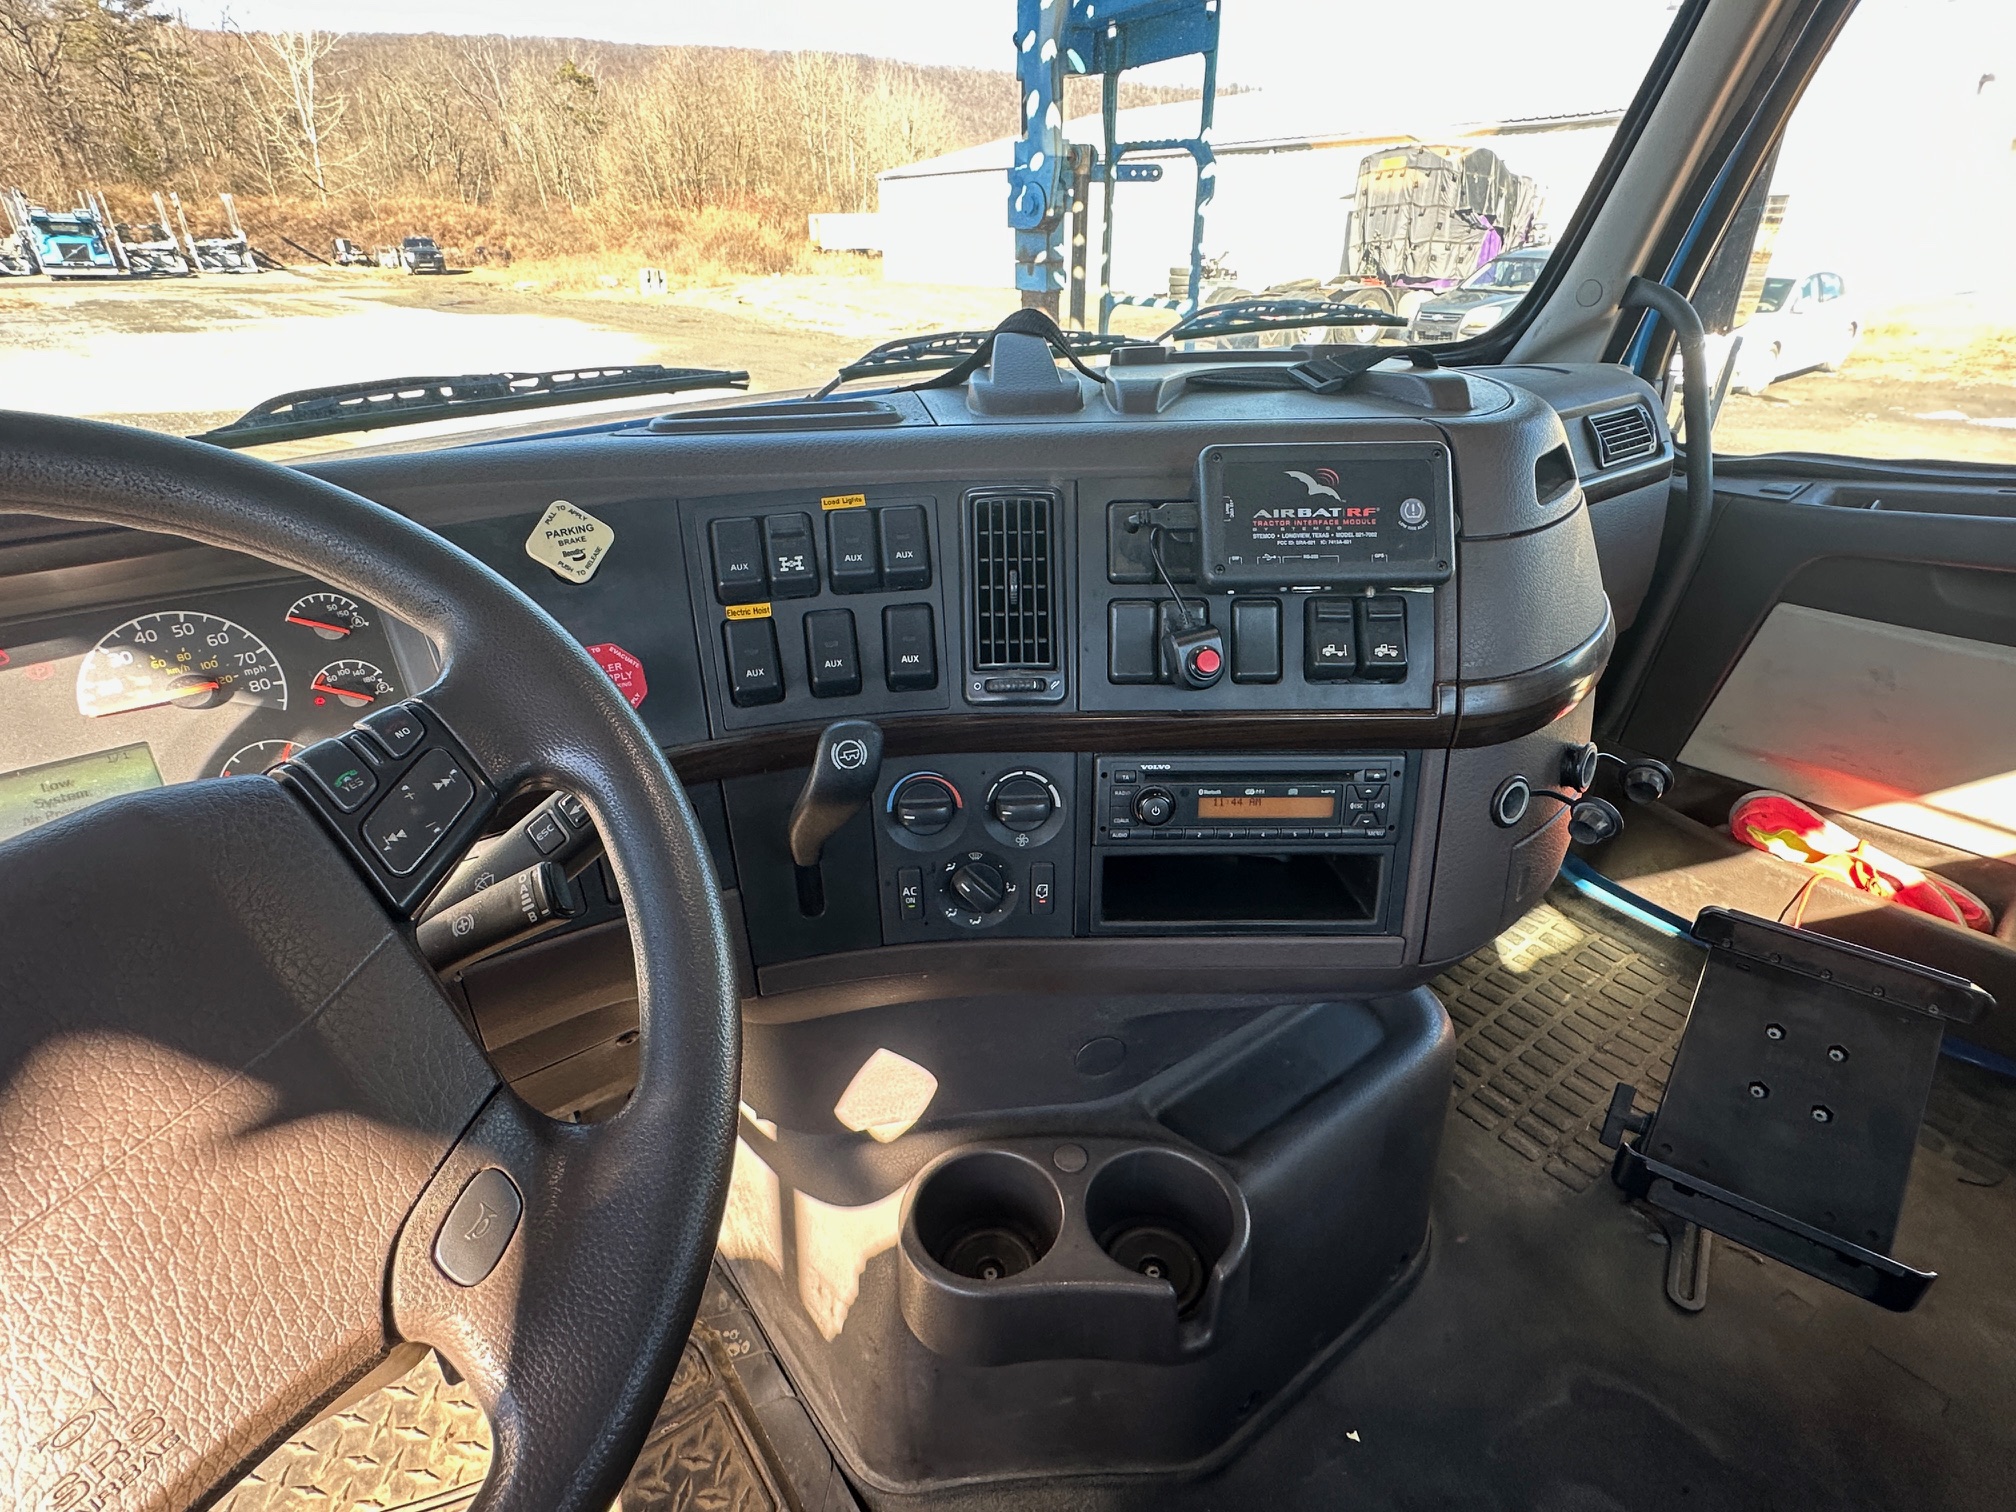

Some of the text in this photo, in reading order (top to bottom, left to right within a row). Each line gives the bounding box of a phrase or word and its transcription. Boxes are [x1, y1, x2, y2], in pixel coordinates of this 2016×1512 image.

[544, 512, 557, 525] PULL
[568, 509, 588, 521] APPLY
[1253, 507, 1376, 518] AIRBAT RF
[545, 523, 595, 540] PARKING
[557, 536, 587, 546] BRAKE
[557, 560, 574, 573] PUSH
[585, 545, 603, 570] RELEASE
[844, 554, 863, 562] AUX
[895, 551, 914, 559] AUX
[730, 563, 749, 571] AUX
[726, 609, 752, 617] Electric
[171, 623, 195, 638] 50
[134, 630, 158, 644] 40
[206, 632, 229, 647] 60
[177, 653, 192, 662] 80
[234, 652, 257, 667] 70
[609, 646, 640, 669] EVACUATE
[824, 659, 843, 668] AUX
[901, 655, 920, 664] AUX
[151, 660, 167, 669] 60
[166, 664, 191, 676] km/h
[200, 660, 219, 670] 100
[244, 665, 267, 677] mph
[746, 668, 765, 678] AUX
[249, 678, 271, 692] 80
[394, 727, 411, 739] NO
[40, 779, 73, 793] Low
[341, 778, 364, 792] YES
[33, 790, 89, 808] System
[1213, 798, 1262, 806] 11:44 AM
[536, 823, 555, 842] ESC
[520, 884, 529, 895] A
[902, 886, 917, 896] AC
[528, 911, 538, 923] B
